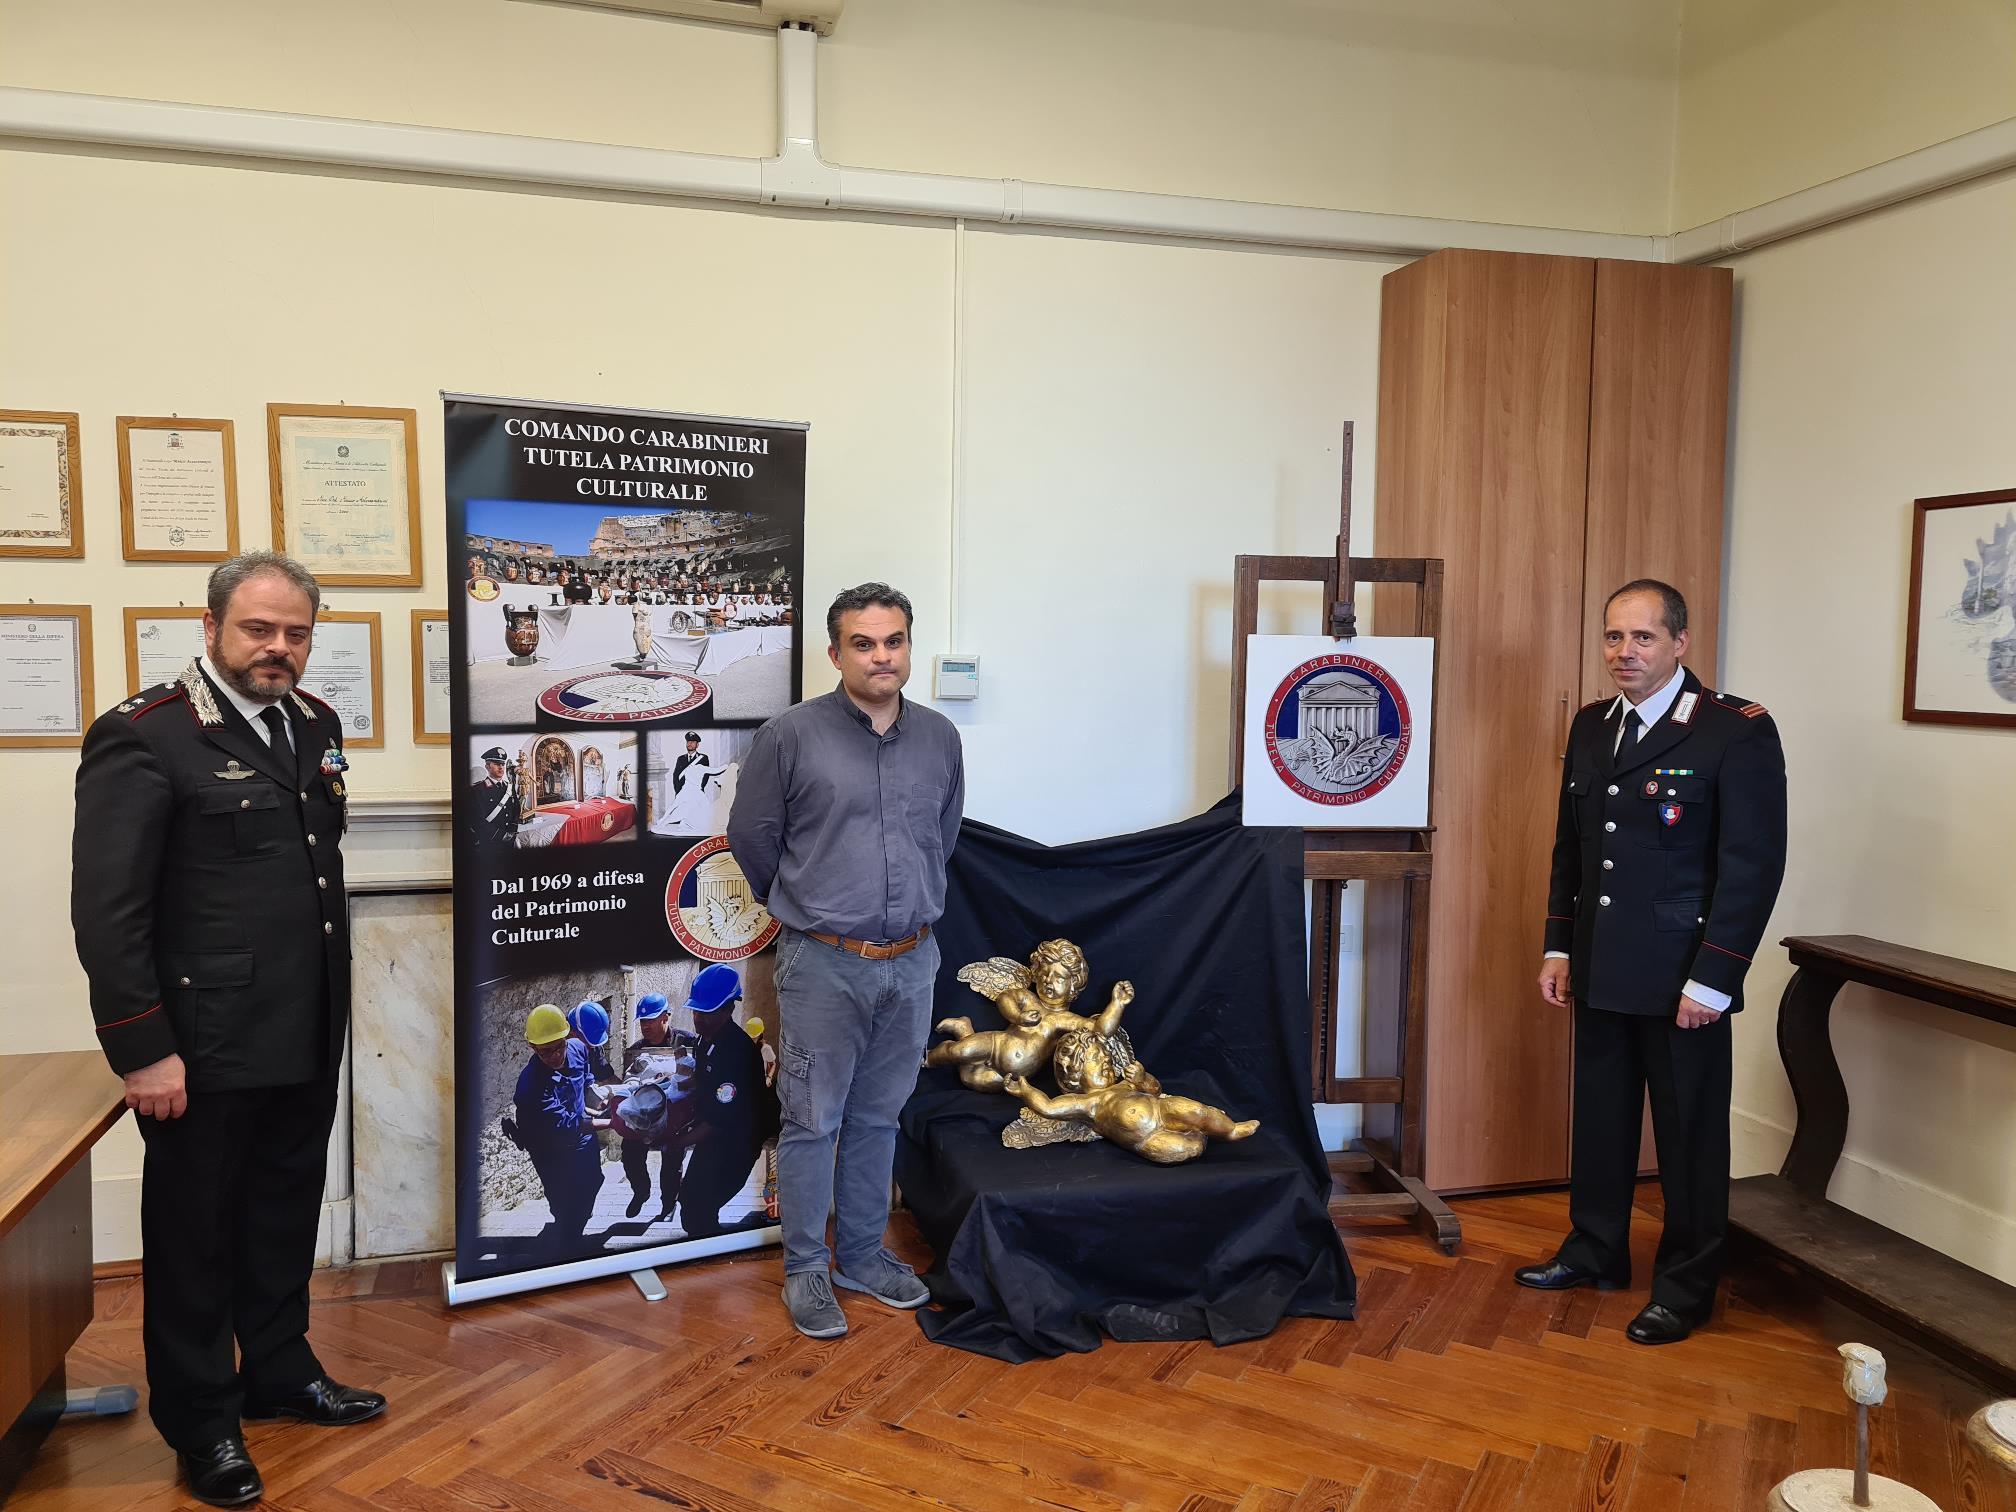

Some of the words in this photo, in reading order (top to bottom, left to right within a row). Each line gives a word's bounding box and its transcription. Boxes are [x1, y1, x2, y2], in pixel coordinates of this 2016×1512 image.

[504, 418, 624, 444] COMANDO
[629, 428, 770, 455] CARABINIERI
[523, 447, 614, 470] TUTELA
[619, 454, 754, 479] PATRIMONIO
[576, 477, 708, 502] CULTURALE
[1290, 655, 1390, 683] CARABINIERI
[559, 707, 615, 720] TUTELA
[1265, 723, 1285, 774] TUTELA
[1291, 781, 1367, 804] PATRIMONIO
[1378, 722, 1410, 786] CULTURALE
[490, 877, 525, 896] Dal
[531, 875, 572, 893] 1969
[577, 878, 589, 889] a
[592, 870, 645, 888] difesa
[491, 903, 521, 922] del
[525, 896, 627, 919] Patrimonio
[491, 924, 580, 946] Culturale
[668, 901, 687, 940] TUTELA
[688, 940, 751, 959] PATRIMONIO
